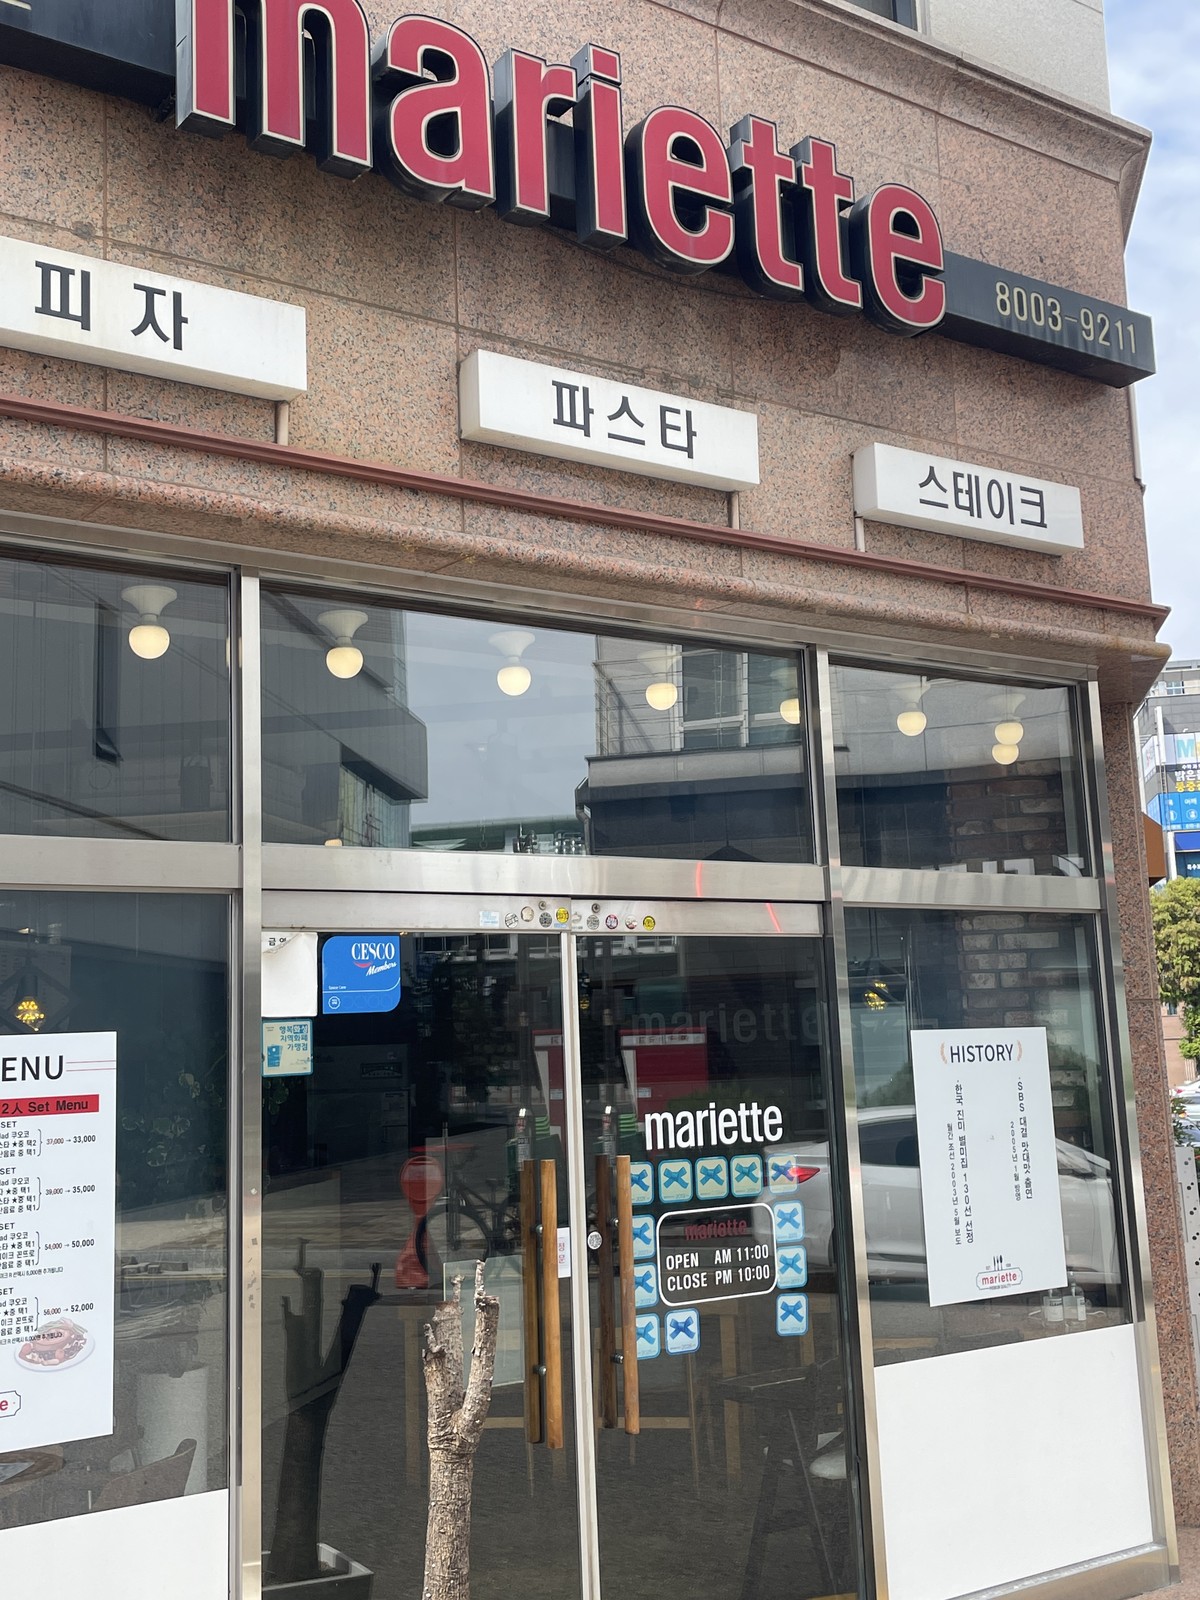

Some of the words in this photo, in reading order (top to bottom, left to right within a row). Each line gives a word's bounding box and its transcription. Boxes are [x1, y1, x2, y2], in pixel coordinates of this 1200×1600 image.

[178, 0, 946, 331] mariette
[996, 281, 1136, 354] 8003-9211
[552, 380, 697, 459] 파스타
[918, 465, 1048, 529] 스테이크
[351, 942, 396, 960] CESCO
[366, 961, 397, 976] Members
[950, 1044, 1014, 1064] HISTORY
[954, 1084, 963, 1106] 한국
[28, 1102, 50, 1112] Set
[56, 1100, 88, 1111] Menu
[645, 1102, 783, 1150] mariette
[73, 1135, 96, 1143] 33,000
[72, 1185, 95, 1193] 35,000
[964, 1172, 972, 1216] 130선
[0, 1222, 15, 1230] SET
[684, 1220, 748, 1240] mariette
[966, 1220, 974, 1244] 선정
[45, 1242, 62, 1250] 54,000
[72, 1239, 94, 1248] 50,000
[666, 1253, 699, 1270] OPEN
[714, 1249, 731, 1265] AM
[737, 1244, 769, 1261] 11:00
[667, 1272, 707, 1291] CLOSE
[715, 1270, 732, 1285] PM
[738, 1265, 770, 1282] 10:00
[982, 1272, 1017, 1285] mariette
[71, 1303, 94, 1312] 52,000
